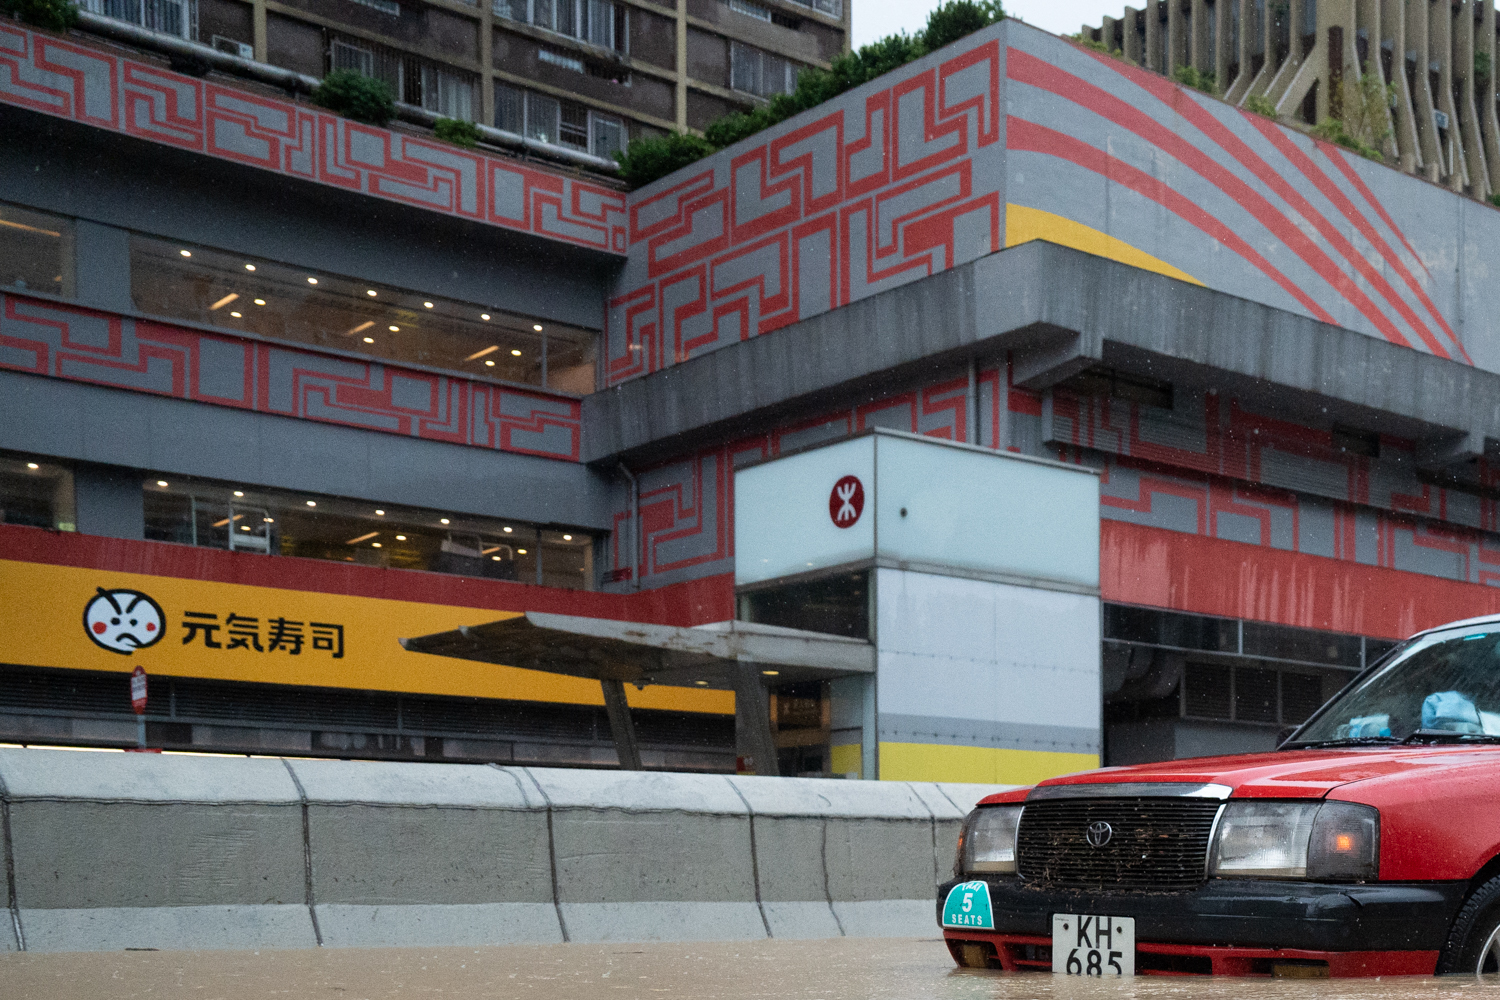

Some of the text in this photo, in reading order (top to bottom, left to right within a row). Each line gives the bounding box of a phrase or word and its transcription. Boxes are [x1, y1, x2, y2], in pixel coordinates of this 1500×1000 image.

[182, 611, 344, 659] 元気寿司
[961, 881, 983, 892] TAXI
[961, 892, 974, 912] 5
[951, 913, 983, 926] SEATS
[1077, 915, 1112, 950] KH
[1066, 948, 1123, 976] 685
